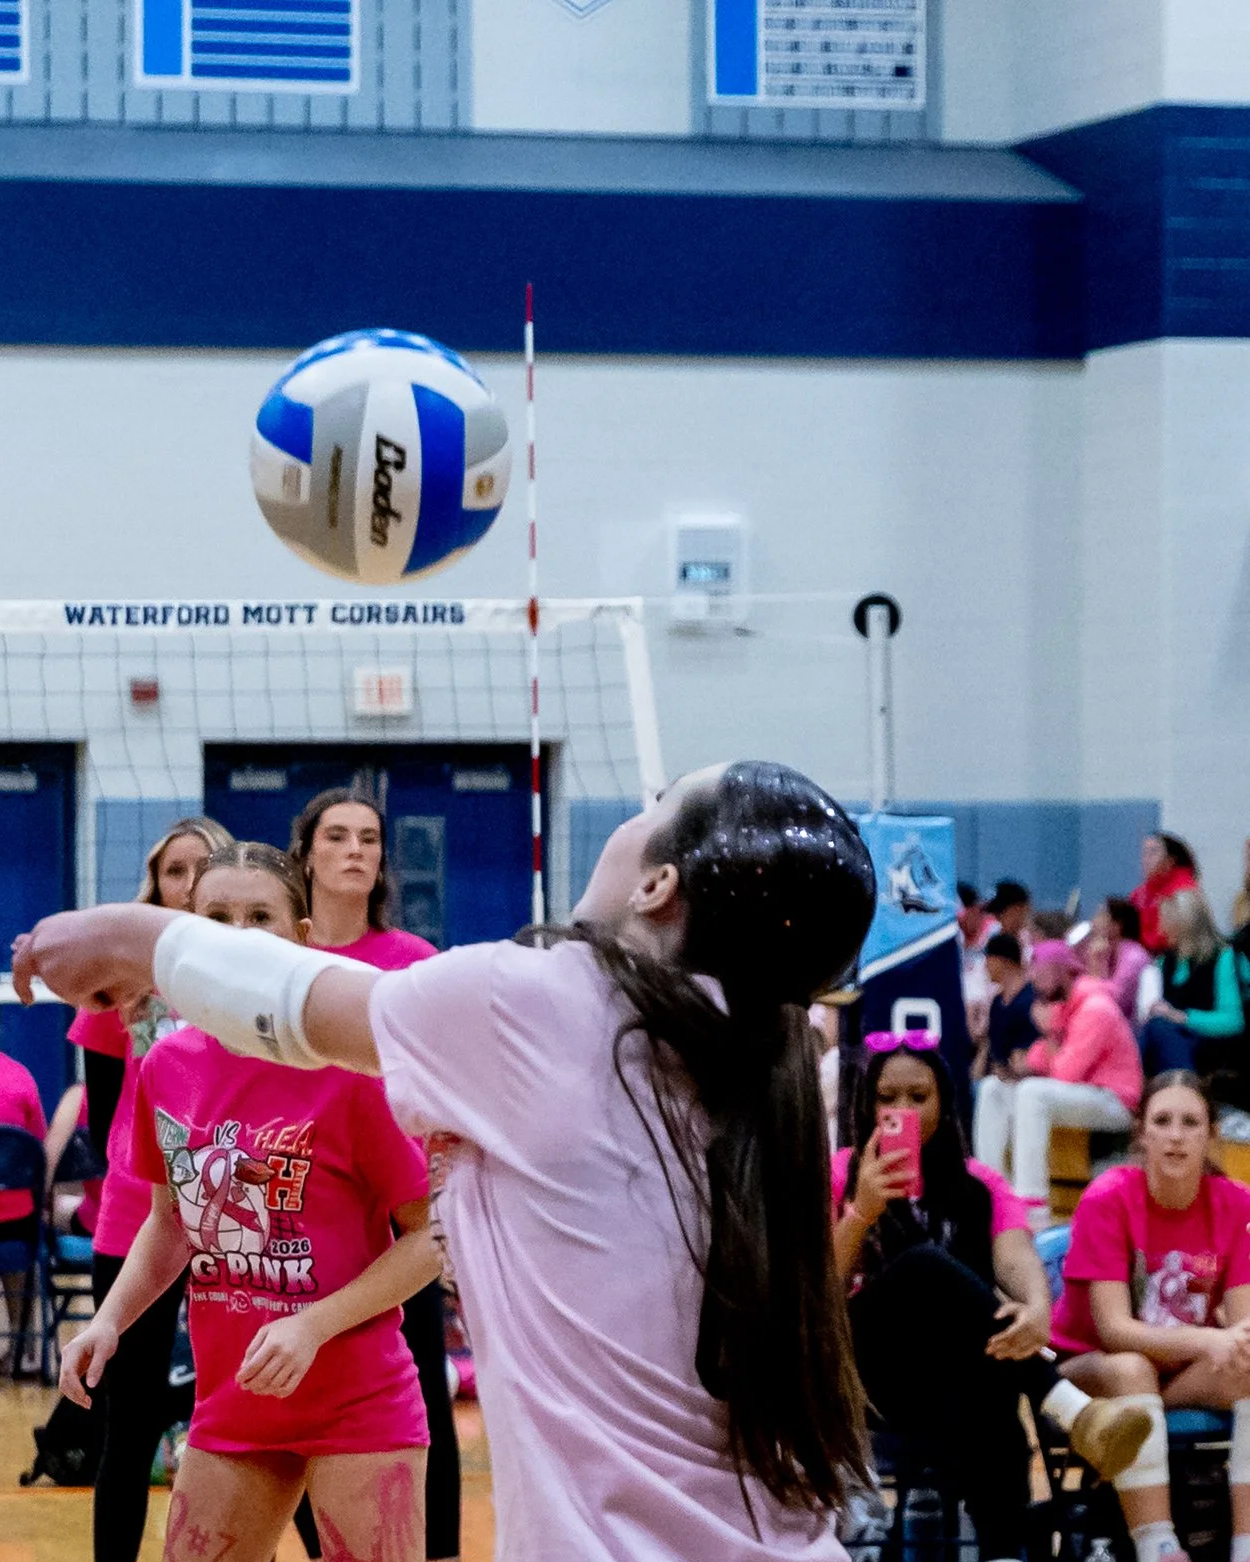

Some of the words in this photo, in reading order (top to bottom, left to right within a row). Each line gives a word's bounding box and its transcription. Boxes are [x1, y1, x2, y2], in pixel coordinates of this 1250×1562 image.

[64, 604, 229, 626] WATERFORD
[242, 604, 319, 625] MOTT
[331, 604, 465, 625] CORSAIRS
[214, 1121, 241, 1147] VS
[270, 1238, 312, 1257] 2026
[224, 1251, 319, 1297] PINK
